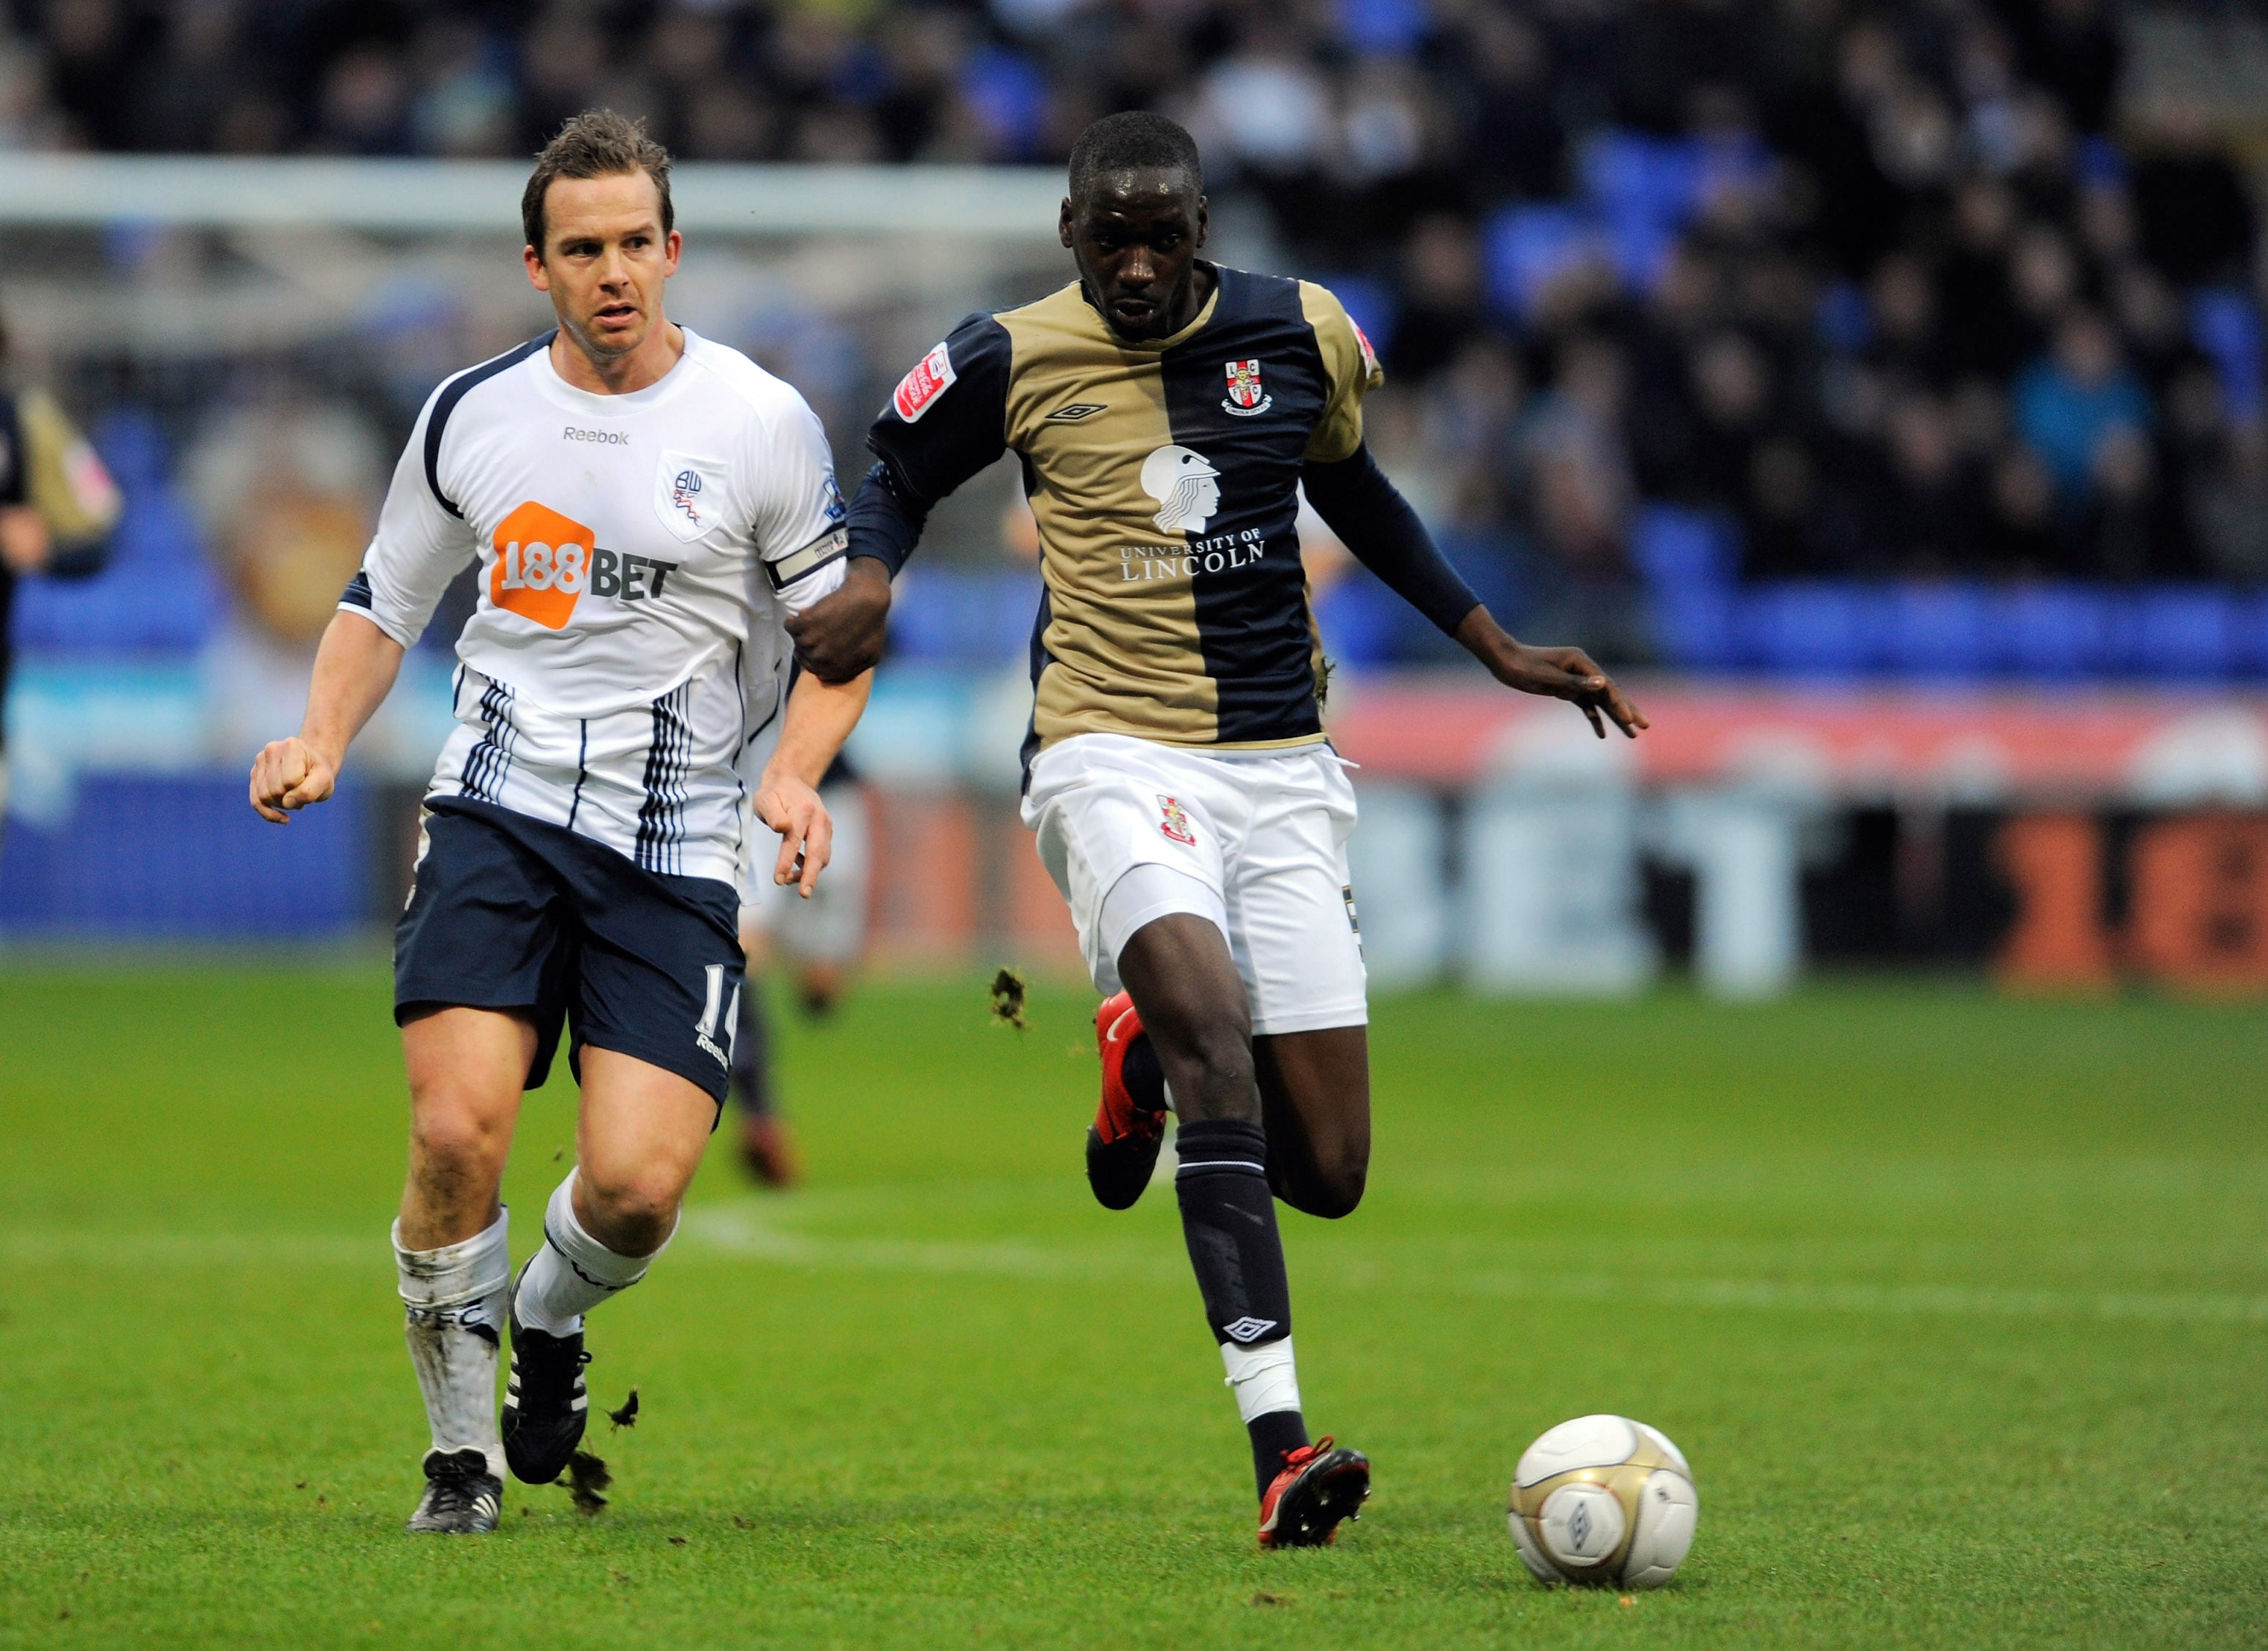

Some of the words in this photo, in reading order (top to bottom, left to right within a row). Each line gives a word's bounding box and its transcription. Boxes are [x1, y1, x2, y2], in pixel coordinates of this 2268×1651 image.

[563, 427, 630, 445] Reebok
[1120, 540, 1266, 581] LINCOLN
[1121, 534, 1235, 559] UNIVERSITY
[1241, 528, 1261, 542] OF
[501, 542, 678, 601] 188BET
